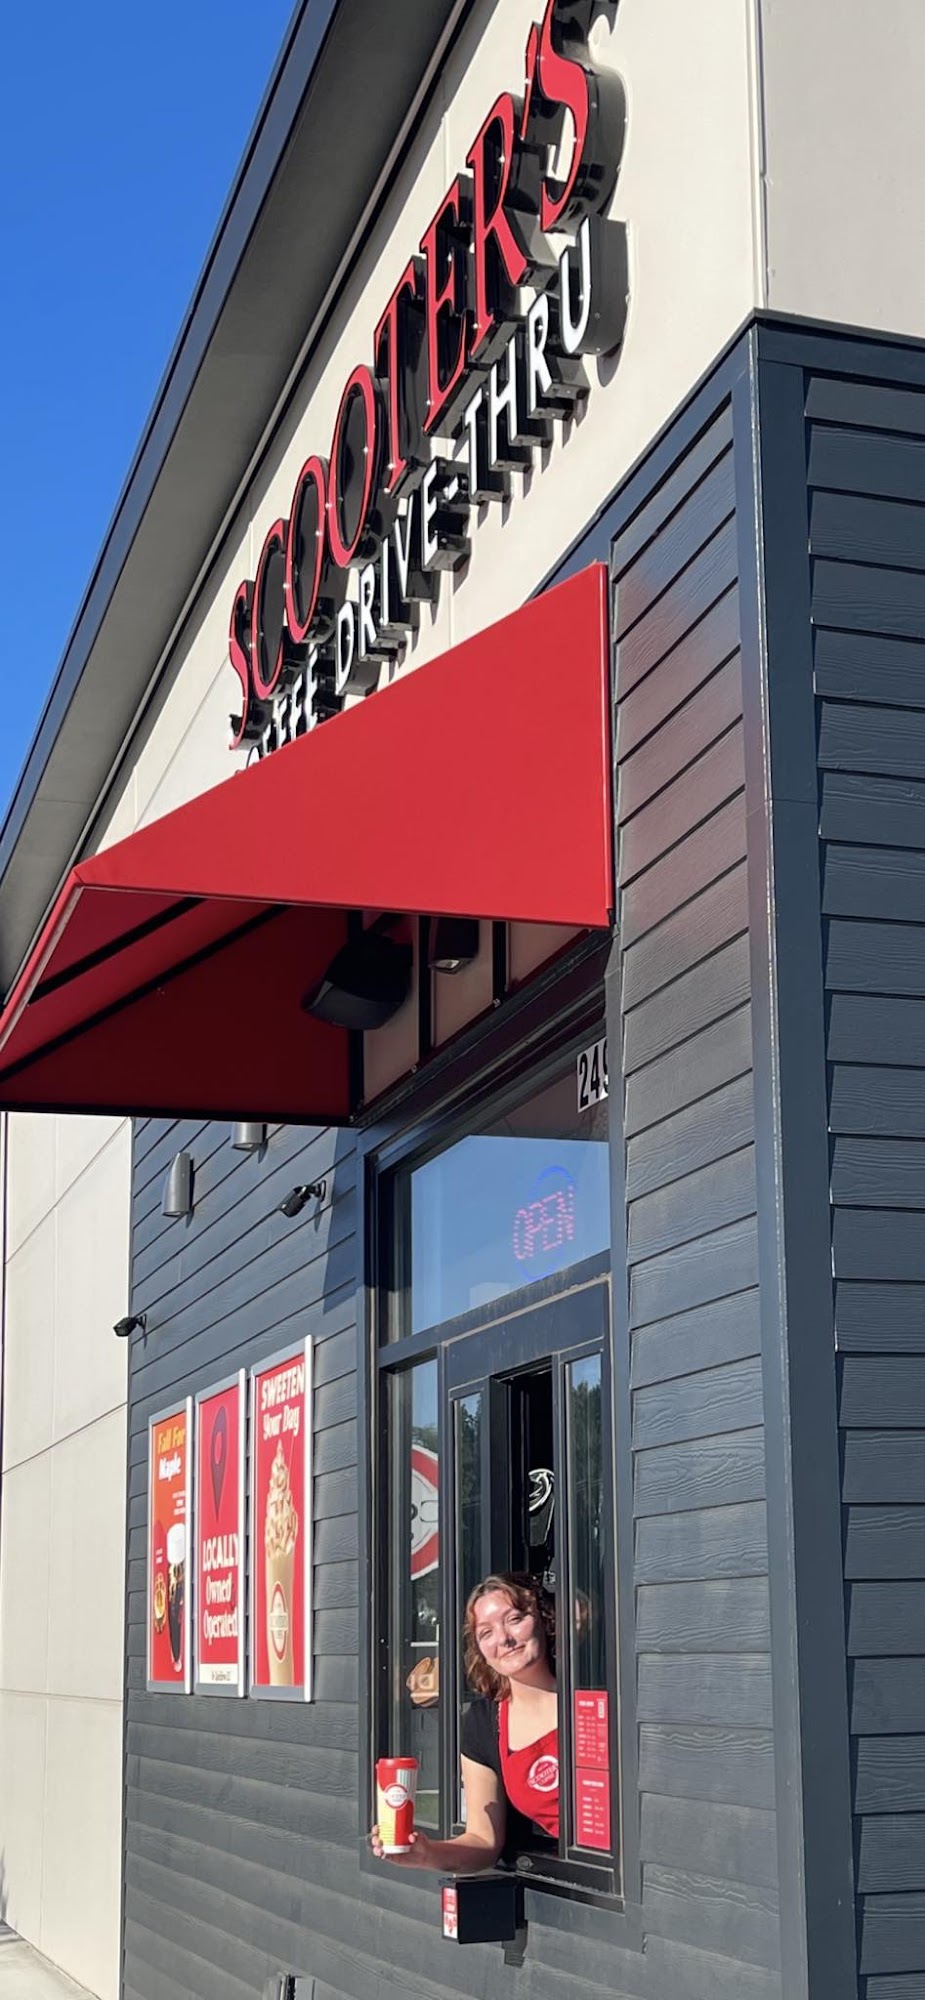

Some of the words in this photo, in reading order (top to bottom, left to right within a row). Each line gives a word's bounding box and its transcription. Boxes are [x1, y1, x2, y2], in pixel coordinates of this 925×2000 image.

[228, 0, 590, 750] SCOOTER'S
[335, 215, 592, 697] DRIVE-THRU
[512, 1184, 576, 1262] OPEN
[261, 1362, 305, 1411] SWEETEN
[263, 1413, 282, 1440] Your
[282, 1404, 300, 1437] Day
[157, 1429, 172, 1455] Fall
[158, 1452, 182, 1482] Maple
[202, 1533, 239, 1572] LOCALLY
[206, 1572, 233, 1605] Owned
[203, 1607, 238, 1645] Operated
